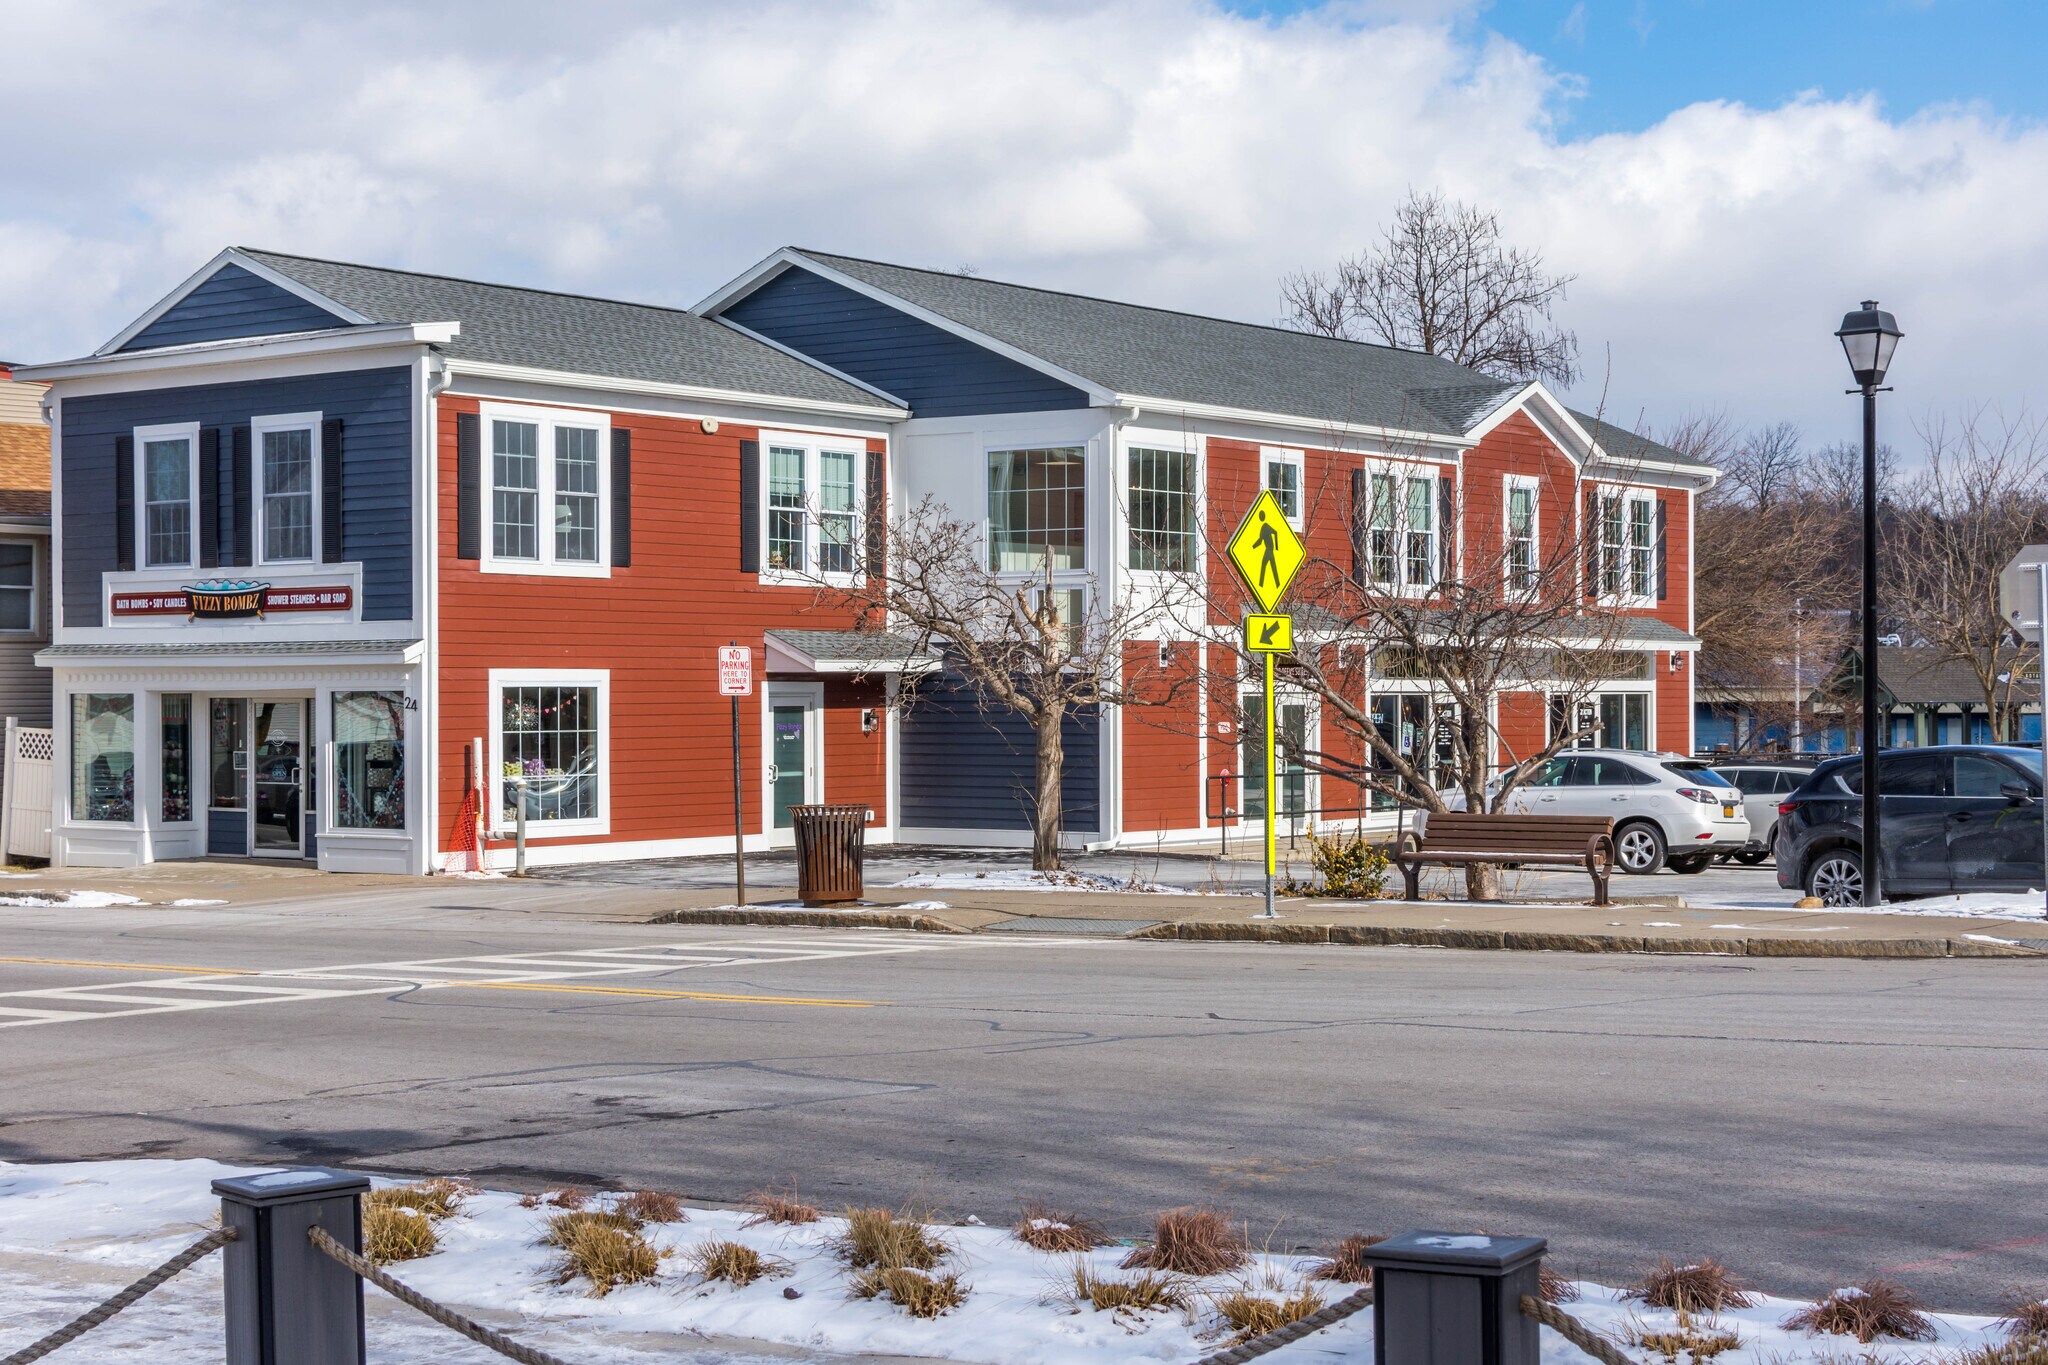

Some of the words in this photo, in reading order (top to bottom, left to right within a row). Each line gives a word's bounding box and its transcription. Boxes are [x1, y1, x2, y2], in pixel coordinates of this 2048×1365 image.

[116, 599, 130, 609] BATH
[130, 599, 149, 609] BOMBS
[153, 598, 164, 608] SOY
[164, 597, 187, 608] CANDLES
[192, 594, 222, 611] FIZZY
[223, 593, 260, 611] BOMBZ
[267, 595, 289, 605] SHOWER
[290, 594, 316, 605] STEAMERS
[320, 593, 332, 604] BAR
[332, 593, 347, 604] SOAP
[729, 651, 741, 661] NO
[721, 660, 749, 670] PARKING
[723, 670, 738, 678] HERE
[740, 670, 748, 678] TO
[723, 677, 747, 685] CORNER
[404, 696, 418, 712] 24
[1371, 713, 1384, 724] PEN
